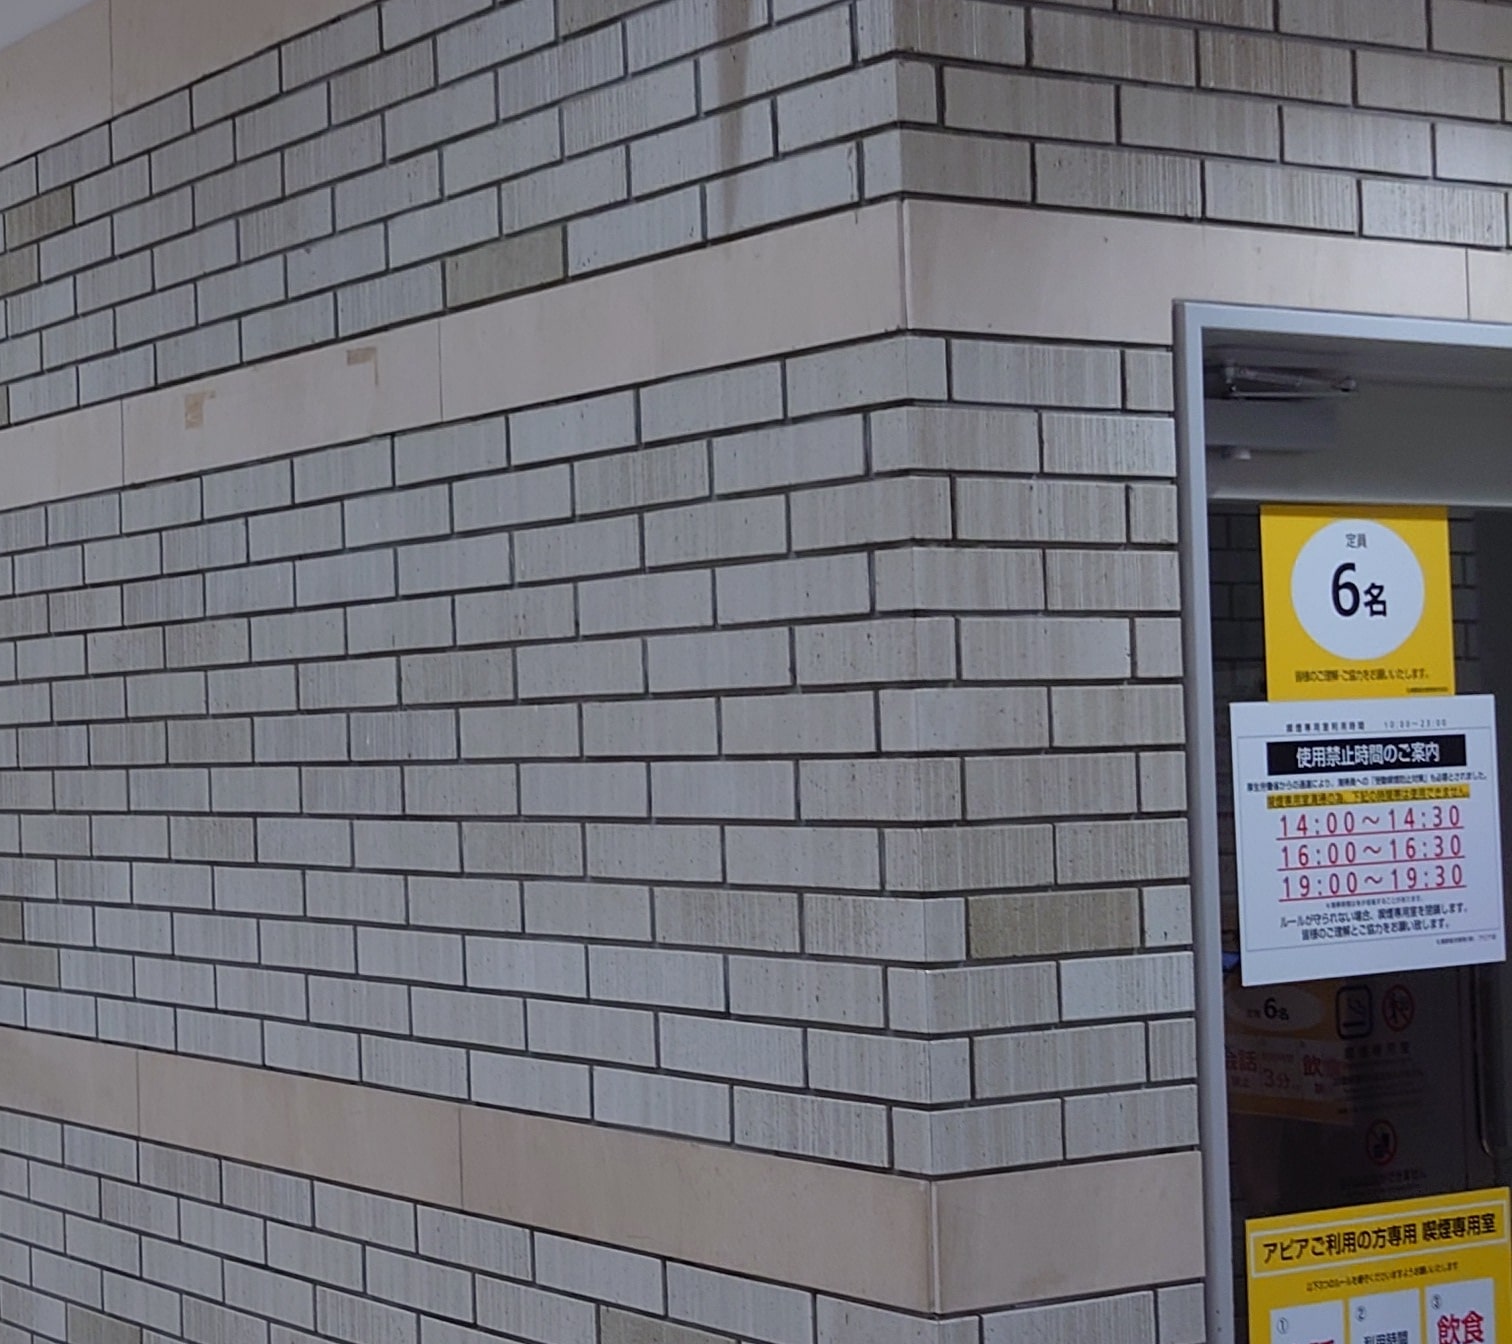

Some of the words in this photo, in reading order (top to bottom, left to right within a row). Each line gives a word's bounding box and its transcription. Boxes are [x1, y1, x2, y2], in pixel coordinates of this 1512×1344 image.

[1345, 533, 1367, 549] 定員
[1331, 562, 1387, 618] 6名
[1296, 741, 1440, 769] 使用禁止時間のご案内
[1263, 1223, 1417, 1264] アピアご利用の方専用
[1422, 1213, 1496, 1243] 喫煙専用室
